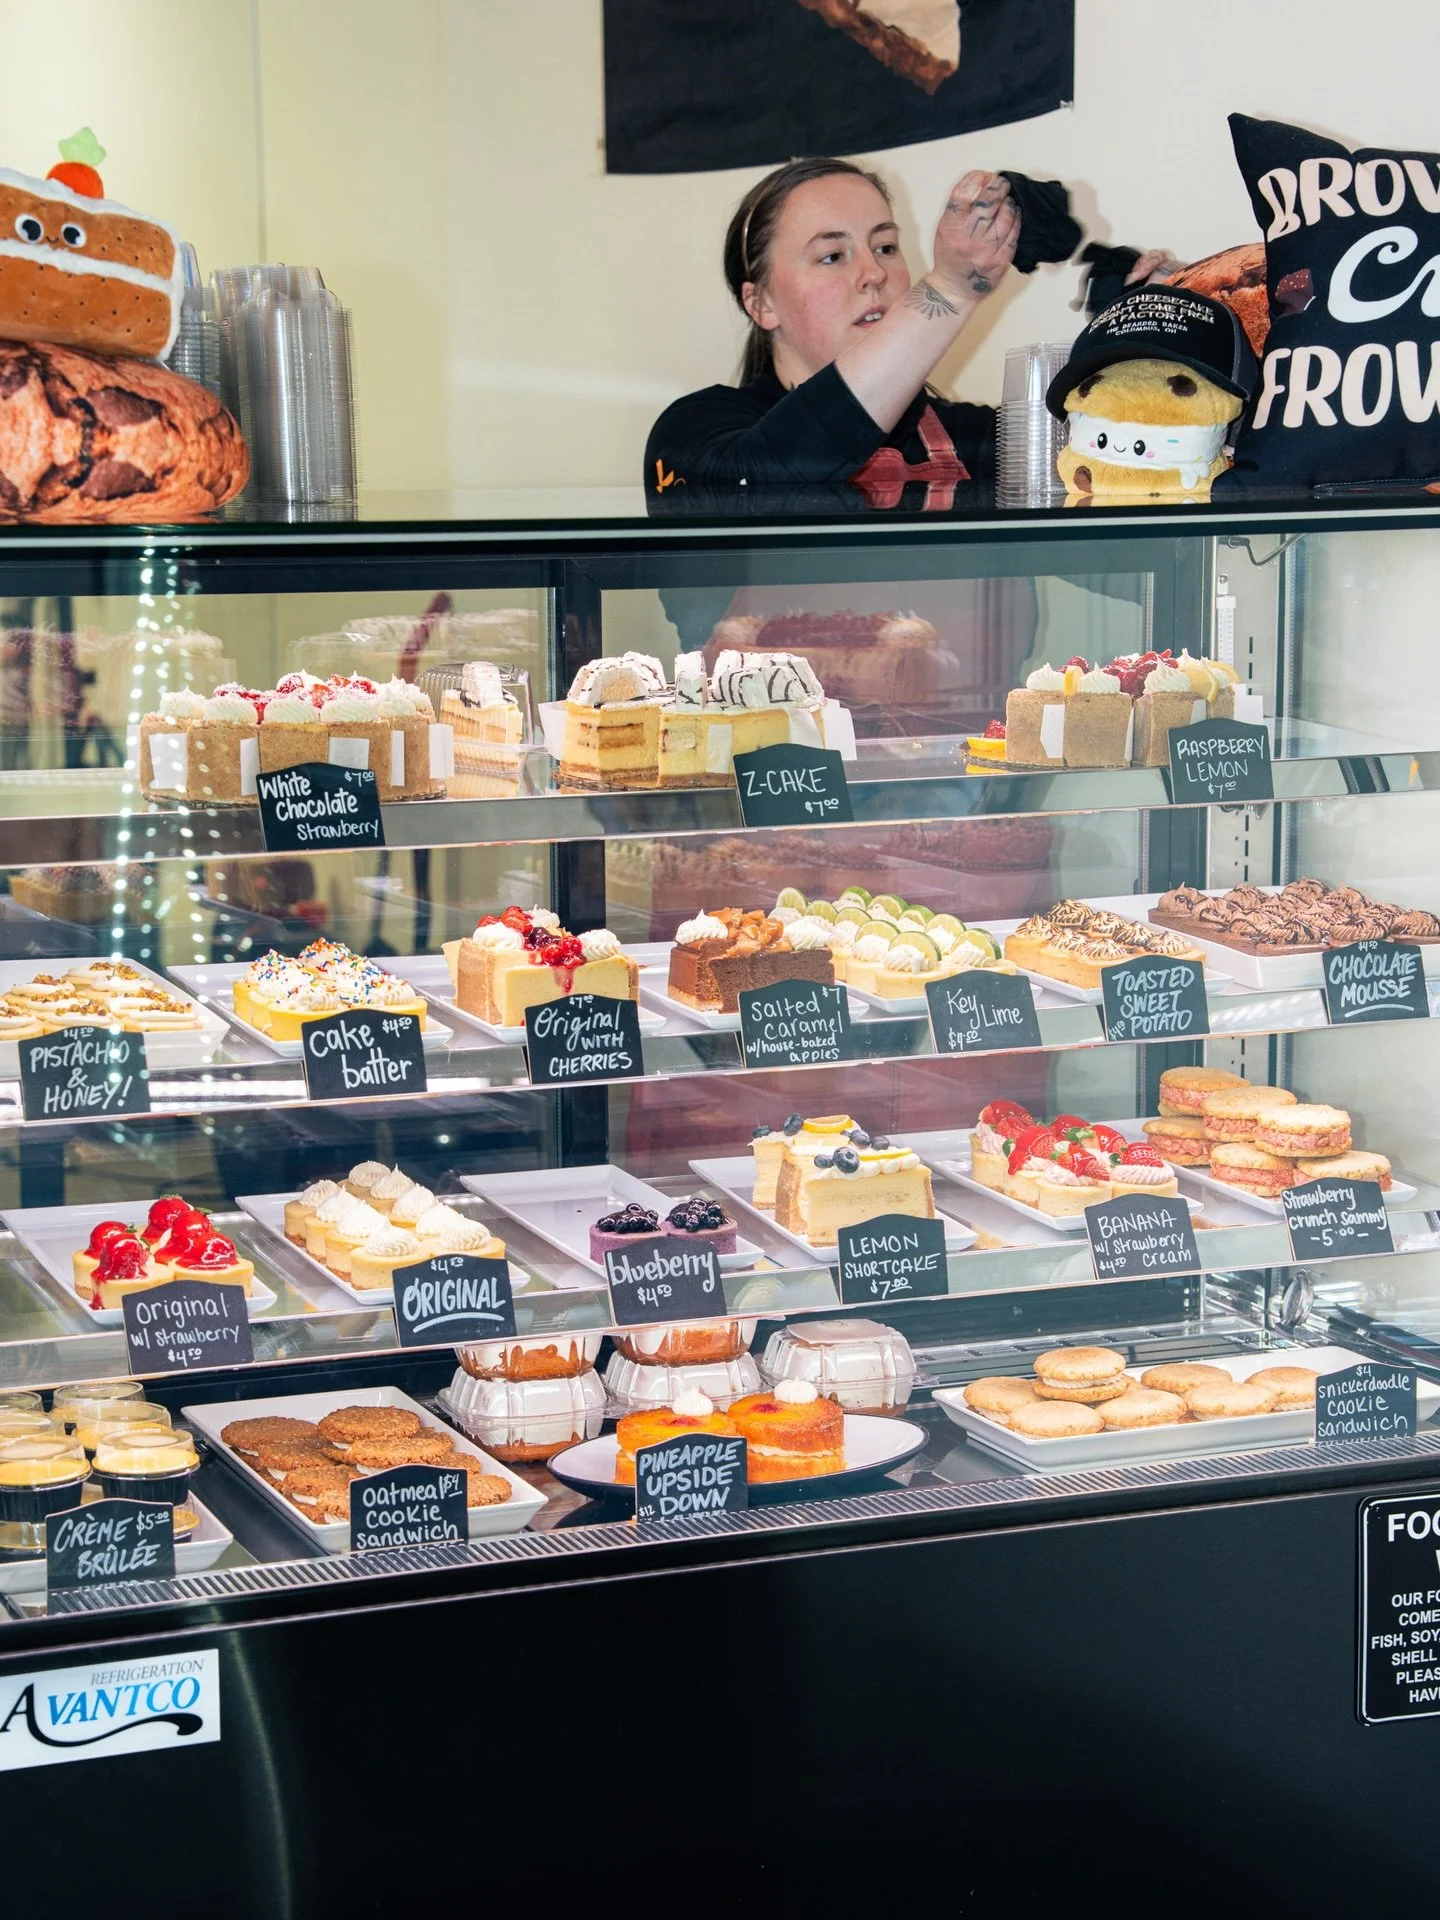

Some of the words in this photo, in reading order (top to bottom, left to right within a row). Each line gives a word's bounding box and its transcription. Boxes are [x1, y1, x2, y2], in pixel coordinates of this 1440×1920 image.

[1127, 294, 1214, 316] CHEESECAKE
[1138, 303, 1176, 313] COME
[1180, 307, 1215, 324] FROM
[1108, 318, 1117, 327] A
[1120, 311, 1187, 322] FACTORY.
[1122, 320, 1158, 329] BEARDED
[1162, 321, 1188, 332] BAKER
[1177, 735, 1264, 760] RASPBERRY
[742, 766, 827, 796] Z-CAKE
[1186, 759, 1248, 782] LEMON
[260, 771, 311, 799] White
[1111, 966, 1195, 996] TOASTED
[1328, 951, 1422, 985] CHOCOLATE
[822, 986, 840, 1004] $7
[1120, 990, 1183, 1018] SWEET
[1340, 975, 1415, 1008] MOUSSE
[946, 988, 980, 1029] Key
[980, 1004, 1024, 1027] Lime
[534, 1001, 622, 1052] Original
[1130, 1009, 1193, 1037] POTATO
[581, 1031, 624, 1050] WITH
[341, 1047, 412, 1089] batter
[549, 1052, 633, 1077] CHERRIES
[790, 1048, 840, 1063] apples
[67, 1067, 88, 1088] &
[44, 1075, 133, 1113] HONEY!
[1097, 1209, 1177, 1239] BANANA
[849, 1232, 918, 1258] LEMON
[1094, 1240, 1110, 1256] w/
[606, 1249, 715, 1293] blueberry
[844, 1253, 941, 1279] SHORTCAKE
[135, 1292, 228, 1329] Original
[402, 1276, 507, 1321] ORIGINAL
[130, 1328, 150, 1349] w/
[1355, 1365, 1372, 1377] $4
[639, 1440, 743, 1476] PINEAPPLE
[646, 1462, 741, 1496] UPSIDE
[659, 1486, 730, 1516] DOWN
[53, 1513, 134, 1553] CRÈME
[77, 1539, 161, 1579] BRÛLÉE
[1391, 1592, 1423, 1607] OUR
[1371, 1633, 1407, 1650] FISH,
[1391, 1649, 1437, 1666] SHELL
[91, 1659, 205, 1686] REFRIGERATION
[1409, 1687, 1440, 1703] HAV
[0, 1677, 203, 1747] AVANTCO
